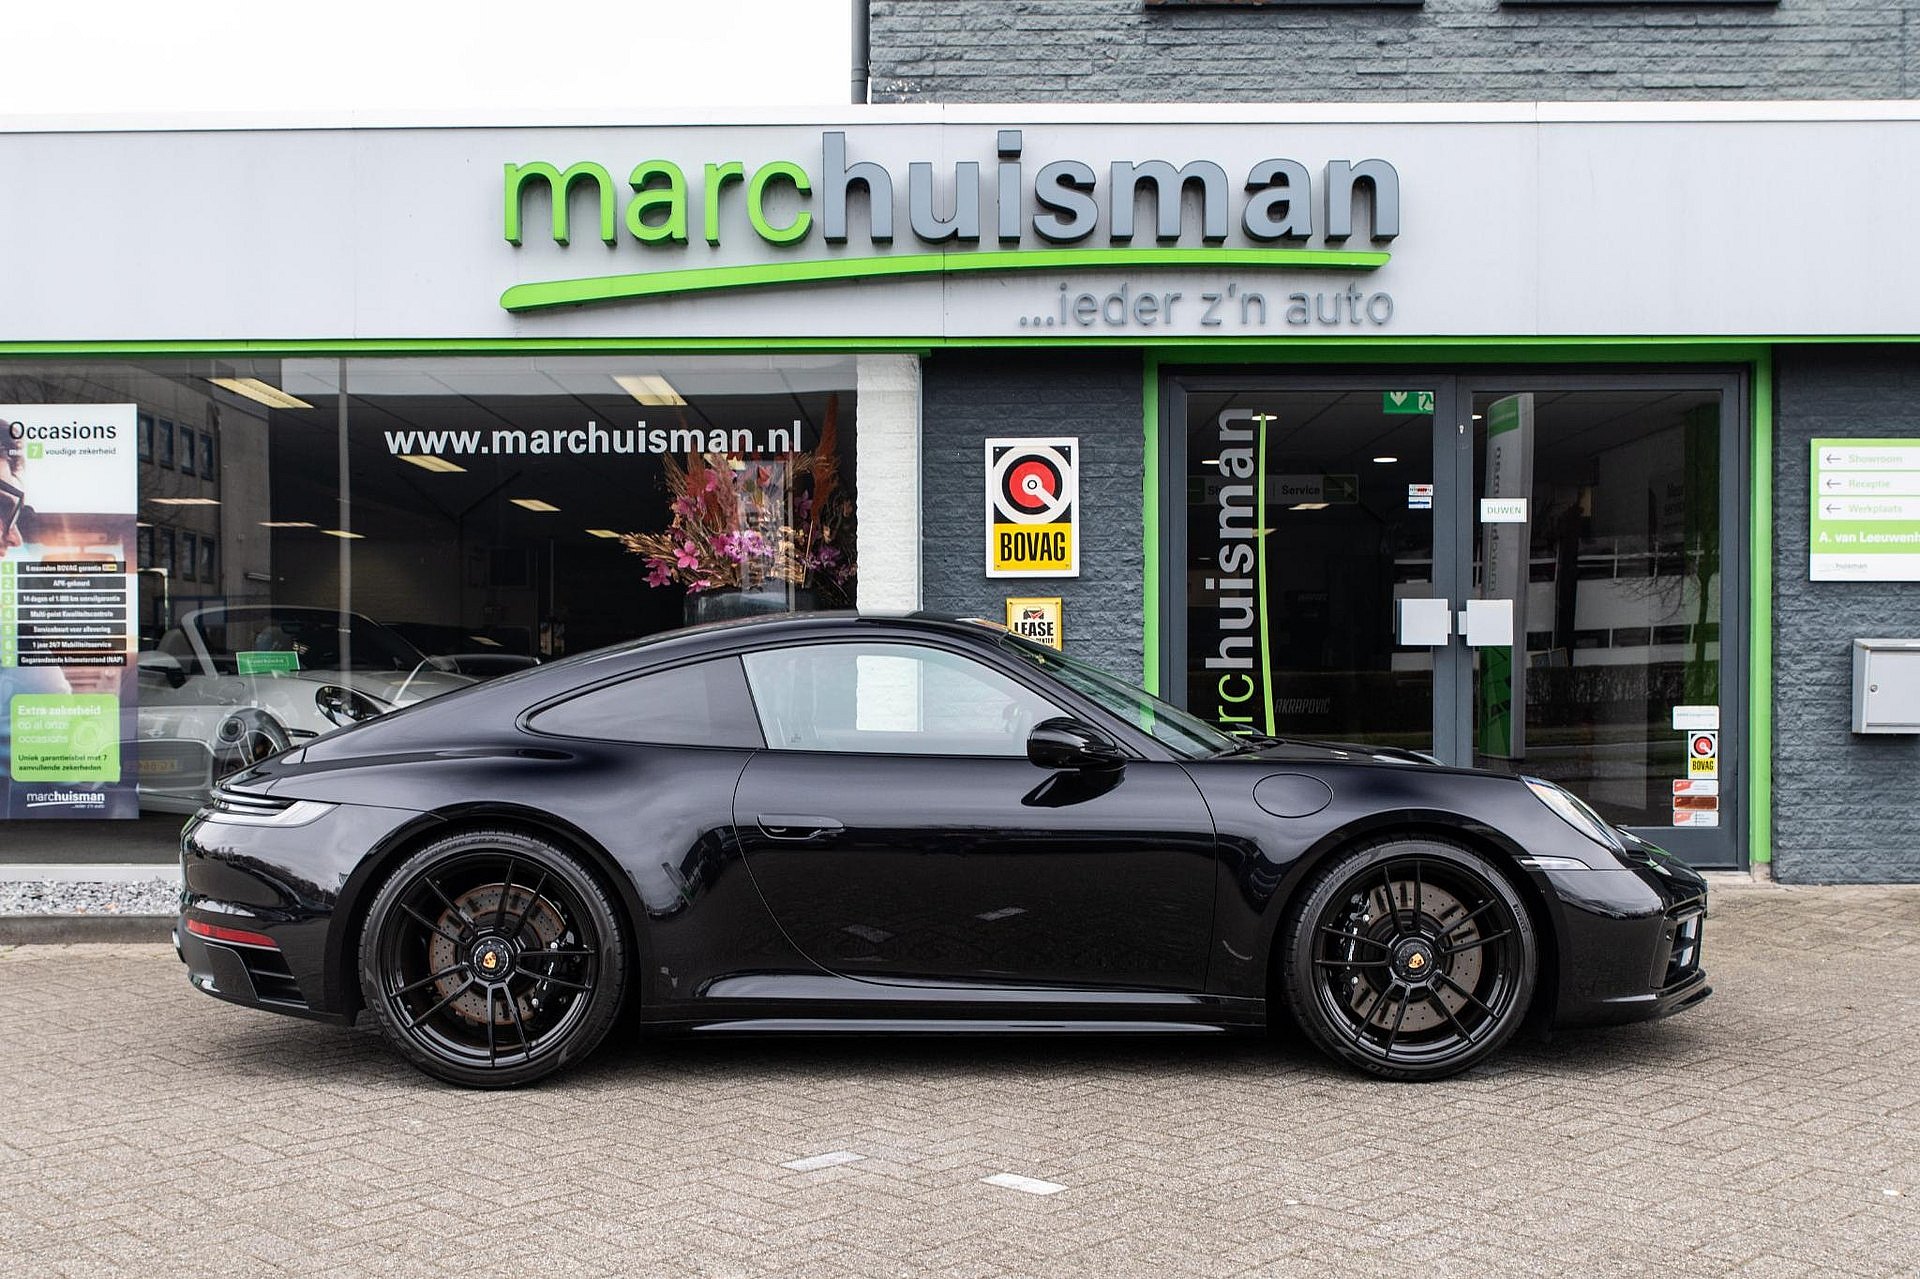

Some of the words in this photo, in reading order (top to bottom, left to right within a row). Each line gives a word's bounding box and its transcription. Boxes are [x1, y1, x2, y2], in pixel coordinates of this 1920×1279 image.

[503, 129, 1400, 246] marchuisman
[1019, 282, 1183, 326] ...ieder
[1200, 282, 1267, 326] z'n
[1286, 282, 1395, 326] auto
[9, 420, 117, 440] Occasions
[384, 419, 802, 455] www.marchuisman.nl
[45, 447, 77, 456] voudige
[78, 447, 117, 455] zekerheid
[1848, 454, 1904, 464] Showroom
[1281, 484, 1321, 496] Service
[1848, 479, 1891, 490] Receptie
[1848, 504, 1903, 515] Werkplaats
[1818, 531, 1832, 543] A.
[1835, 533, 1857, 543] van
[1000, 531, 1066, 562] BOVAG
[1205, 408, 1254, 735] rchuisman
[1014, 621, 1054, 637] LEASE
[18, 705, 47, 716] Extra
[49, 705, 102, 716] zekerheid
[1692, 760, 1714, 771] BOVAG
[26, 790, 105, 802] marchuisman
